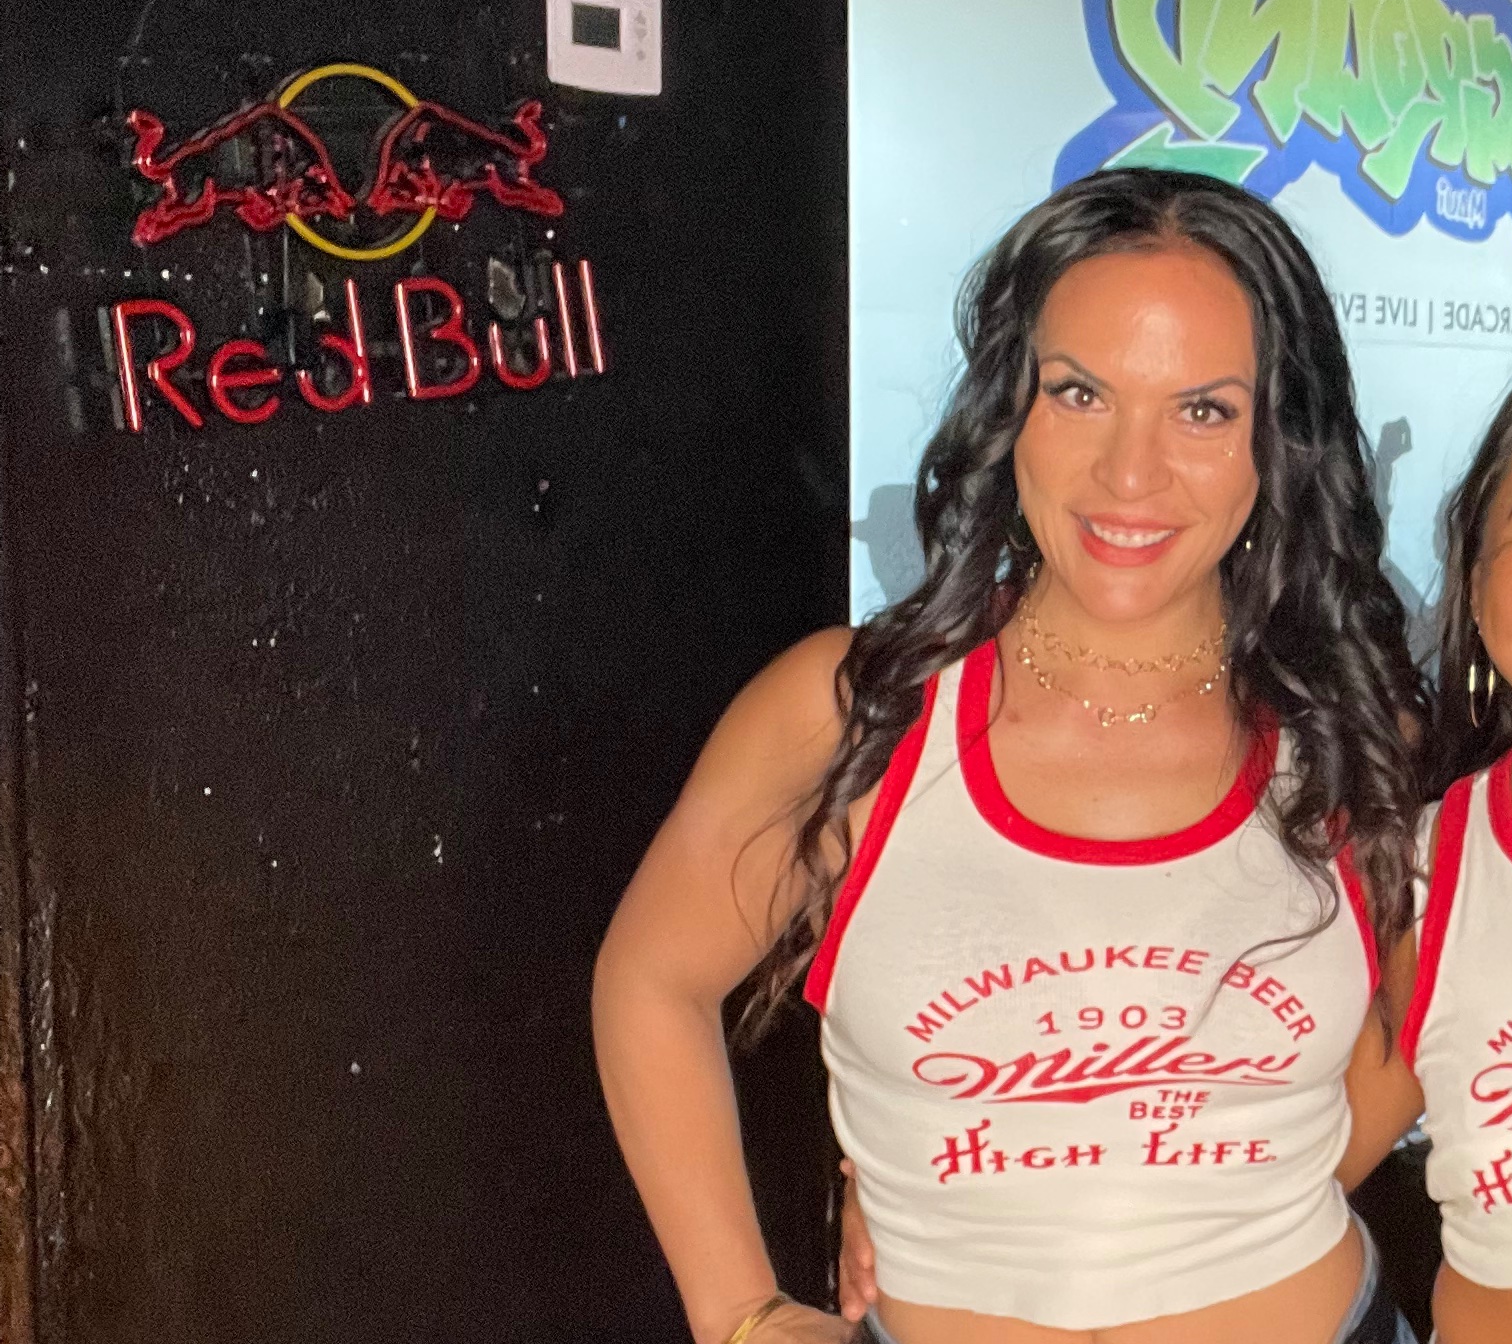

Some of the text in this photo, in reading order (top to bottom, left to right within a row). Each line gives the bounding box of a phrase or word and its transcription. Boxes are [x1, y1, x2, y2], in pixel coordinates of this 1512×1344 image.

[112, 258, 606, 433] Red Bull
[905, 945, 1317, 1043] MILWAUKEE BEER
[1036, 1004, 1188, 1036] 1903
[1157, 1088, 1210, 1104] THE
